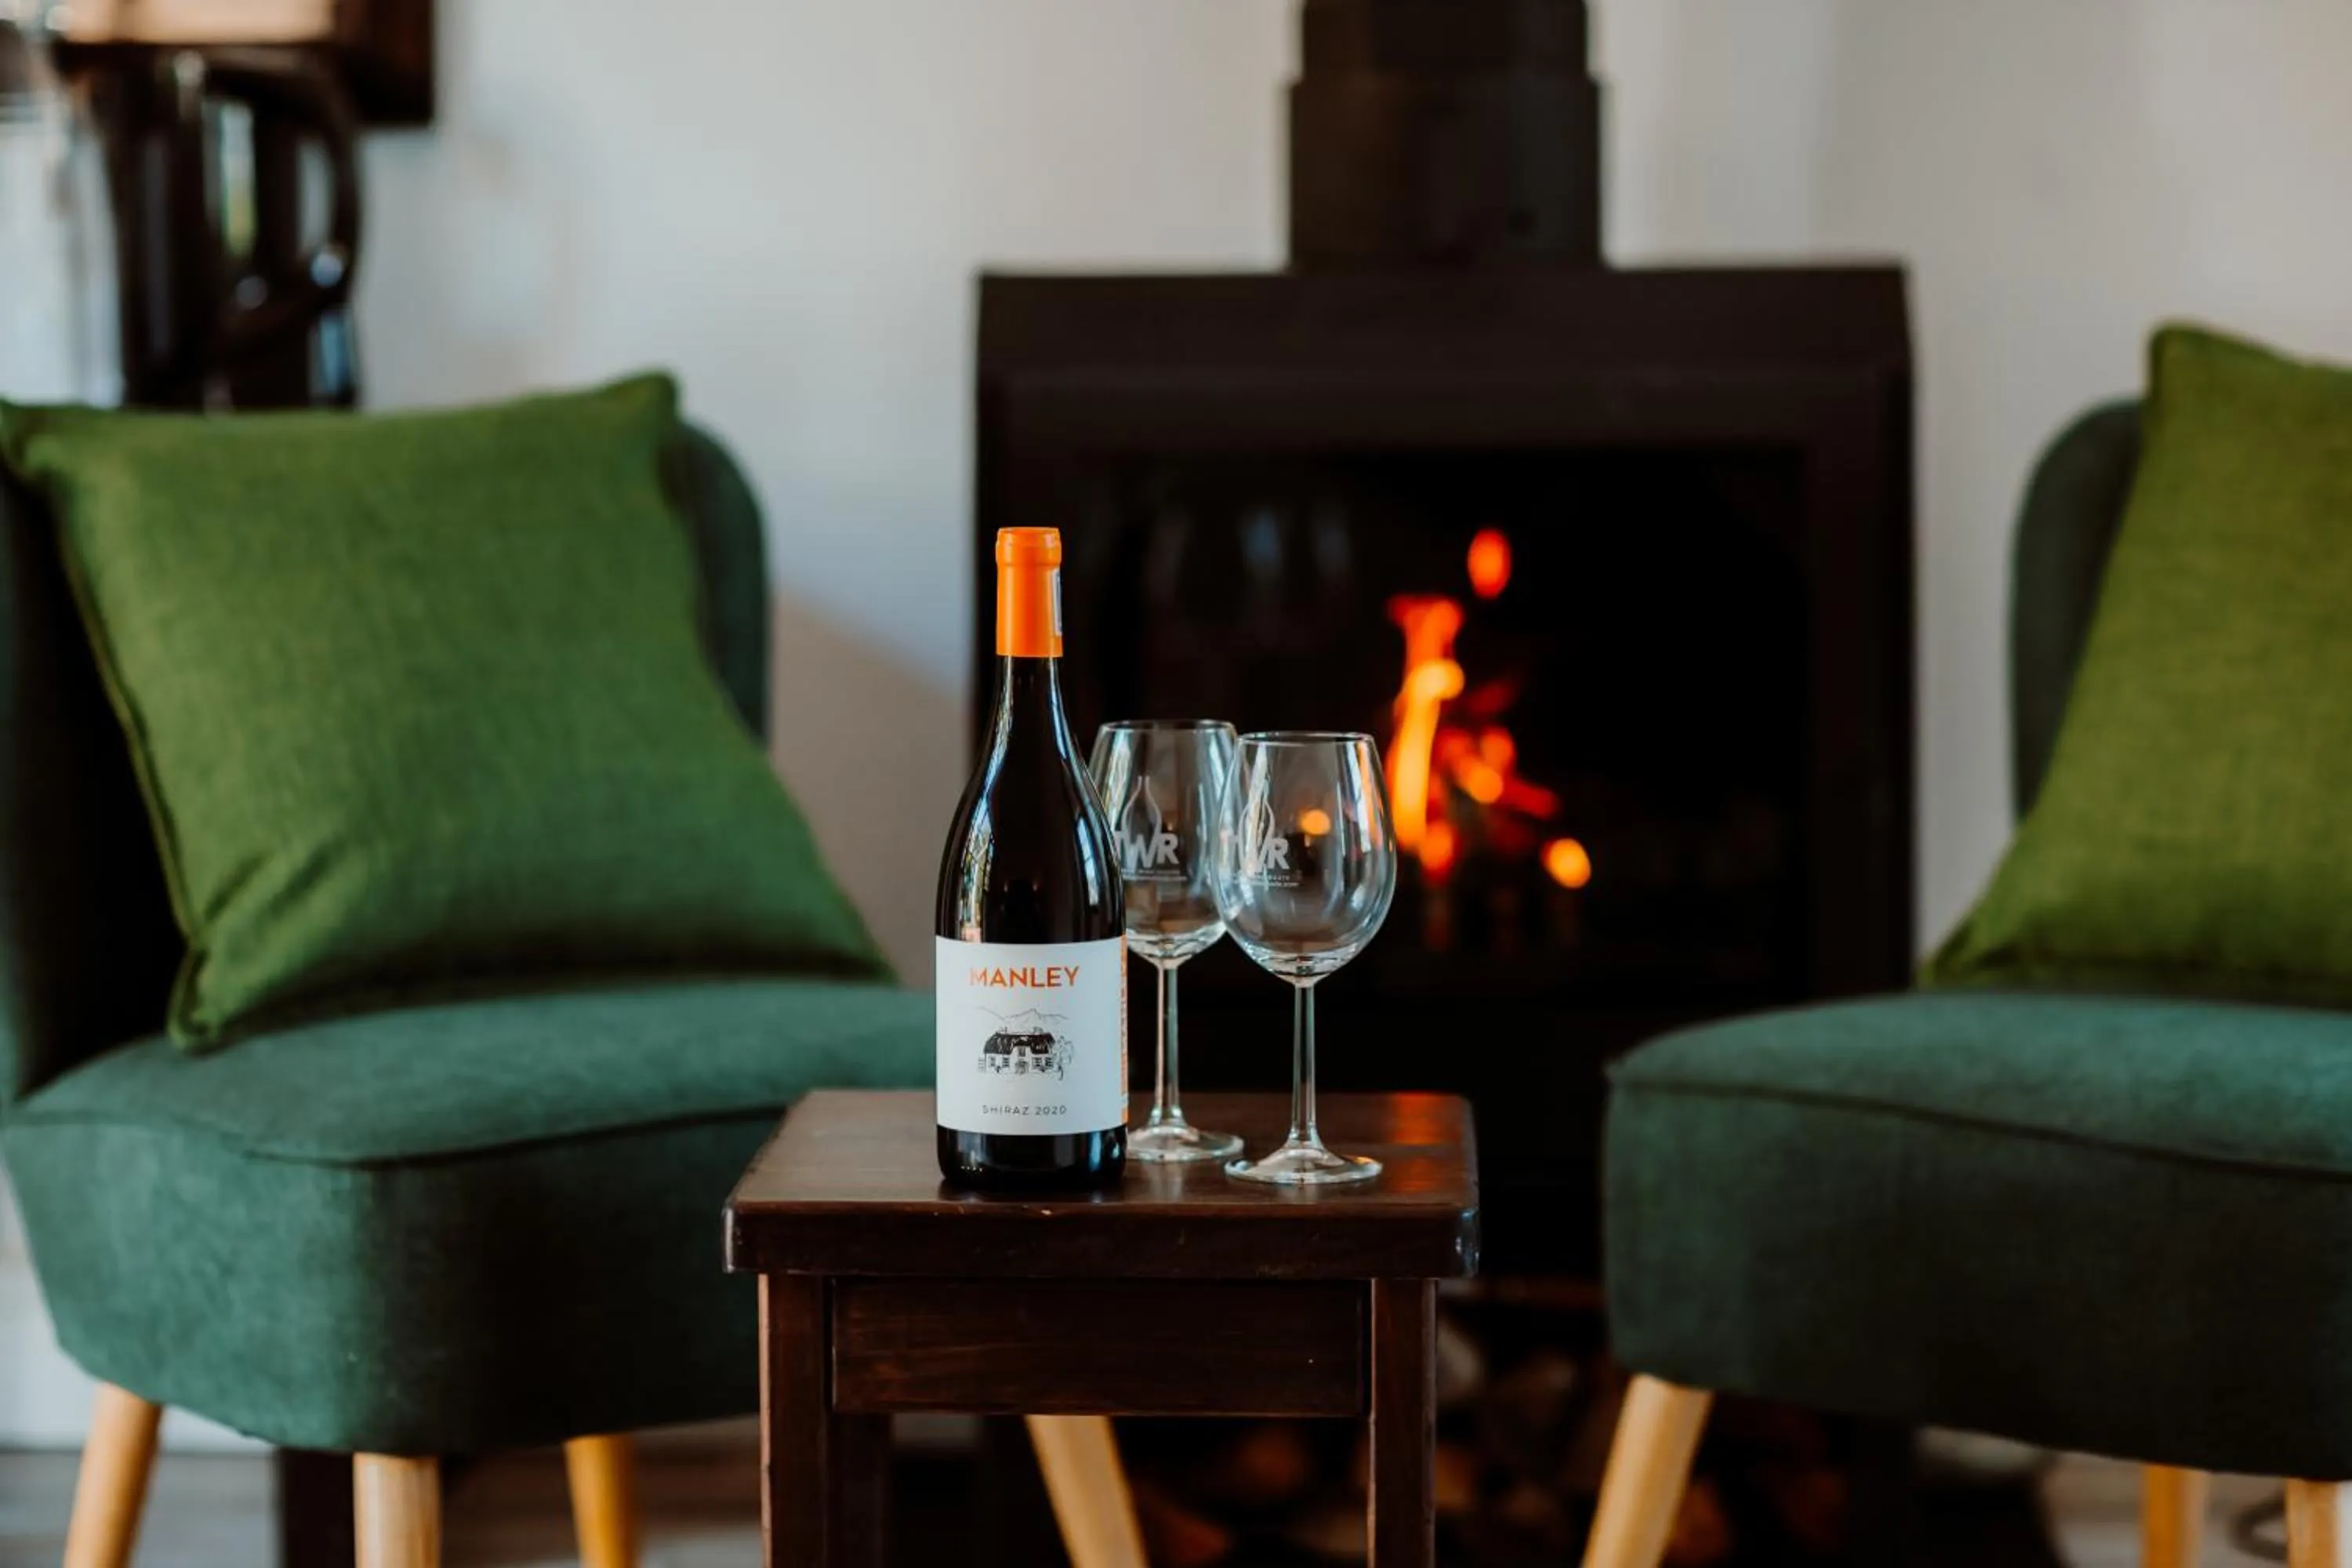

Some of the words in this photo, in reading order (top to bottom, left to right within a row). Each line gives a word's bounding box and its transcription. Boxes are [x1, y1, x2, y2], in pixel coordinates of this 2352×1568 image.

[970, 966, 1080, 988] MANLEY
[982, 1105, 1029, 1115] SHIRAZ
[1035, 1104, 1067, 1115] 2020
